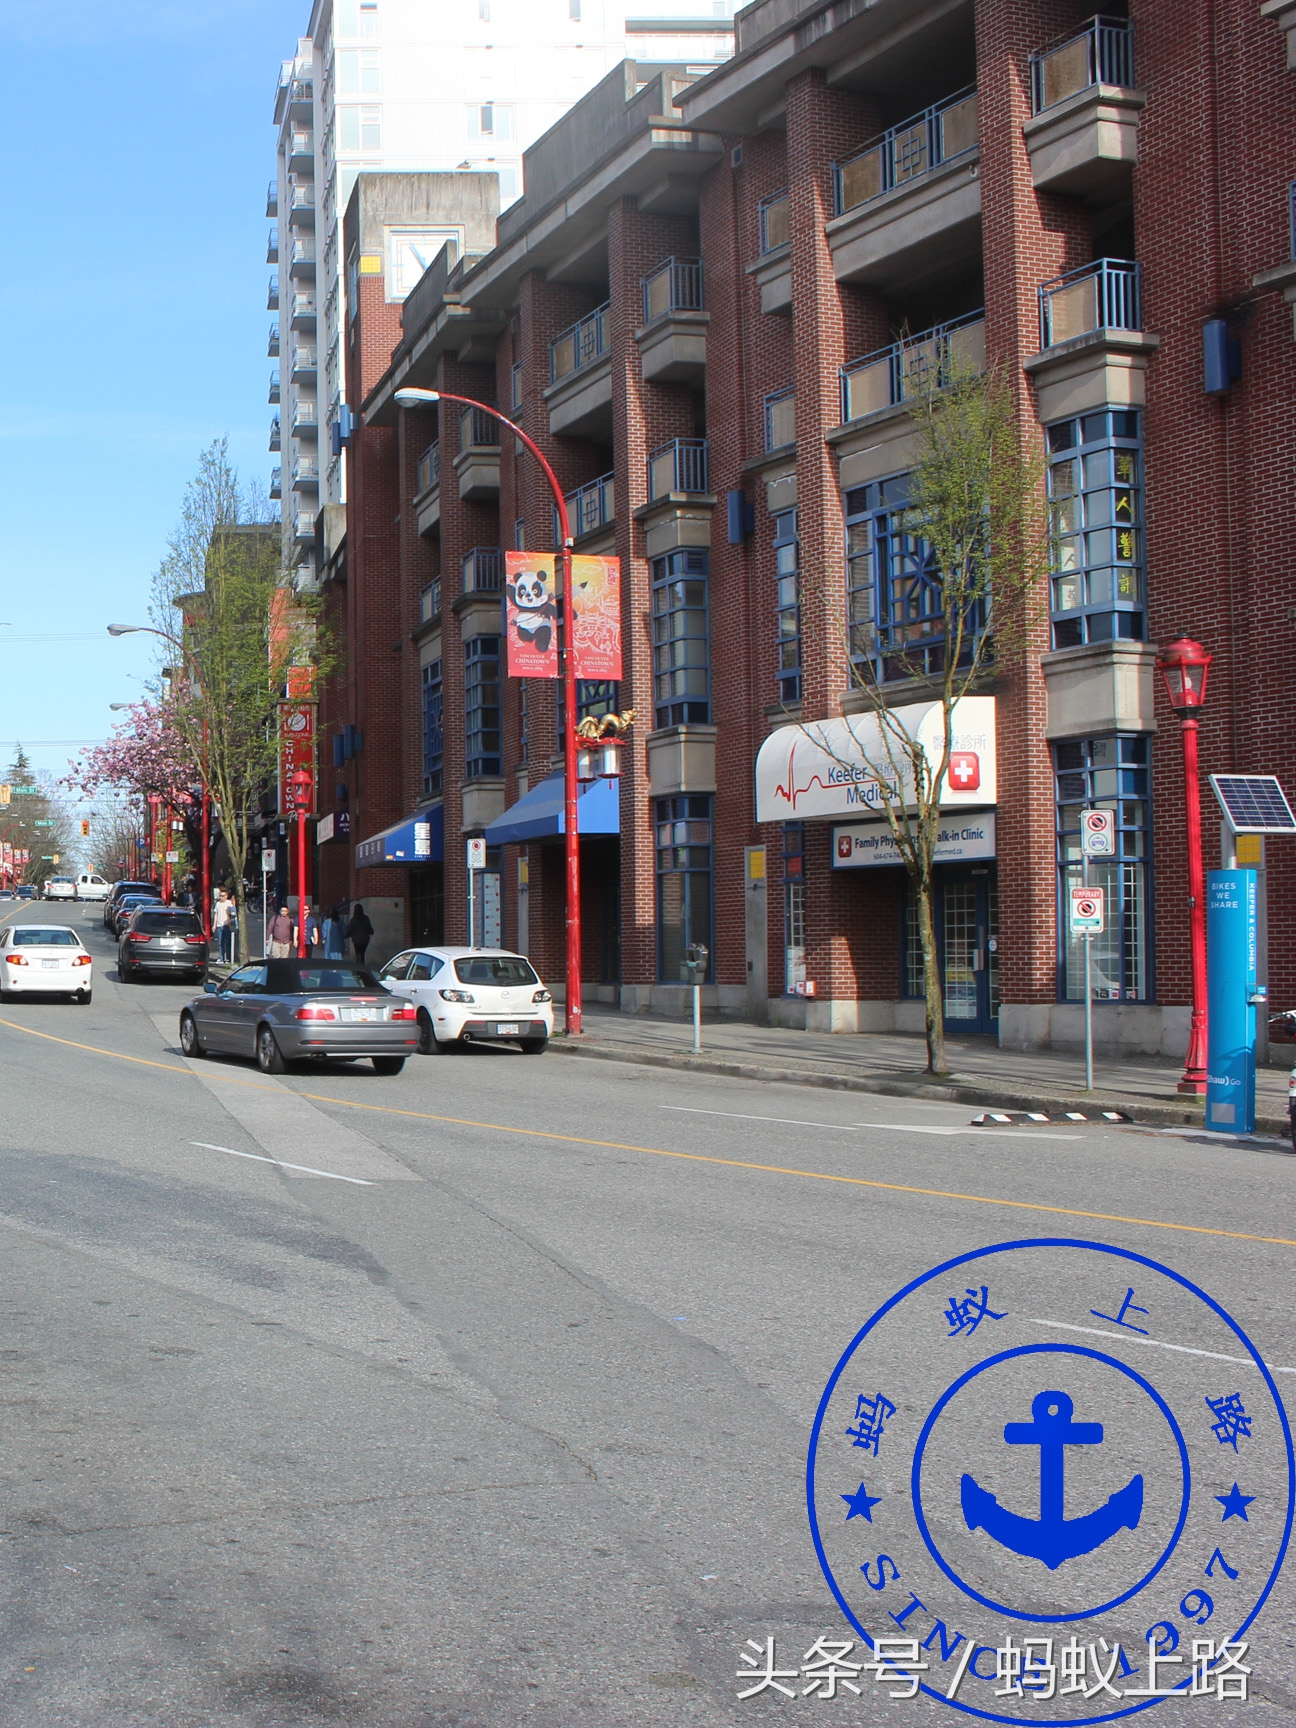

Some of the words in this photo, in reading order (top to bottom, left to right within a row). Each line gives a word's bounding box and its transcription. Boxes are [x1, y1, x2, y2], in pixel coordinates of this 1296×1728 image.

[828, 763, 867, 784] Keefer
[847, 780, 897, 804] Medical
[855, 836, 879, 850] Family
[961, 828, 984, 841] Clinic
[1211, 882, 1237, 890] BIKES
[1073, 890, 1101, 898] TEMPORARY
[1210, 900, 1239, 909] SHARE
